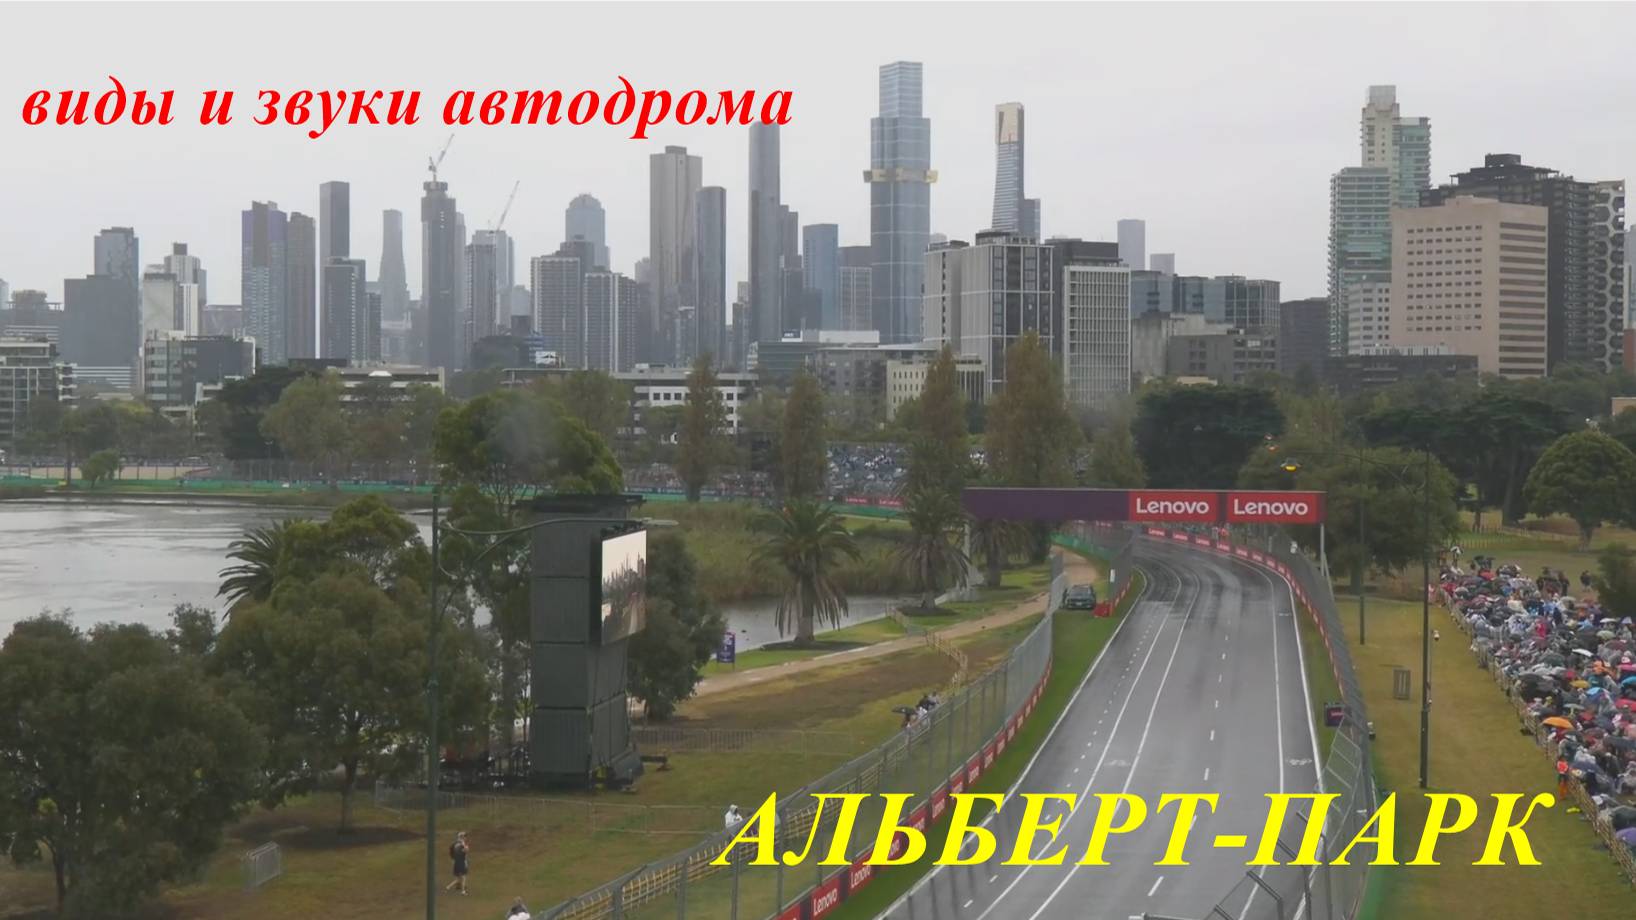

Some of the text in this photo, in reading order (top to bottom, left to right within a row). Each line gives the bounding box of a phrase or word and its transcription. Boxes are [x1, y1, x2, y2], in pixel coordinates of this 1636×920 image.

[1136, 498, 1210, 515] Lenovo
[1234, 499, 1309, 516] Lenovo
[813, 888, 838, 916] Lenovo
